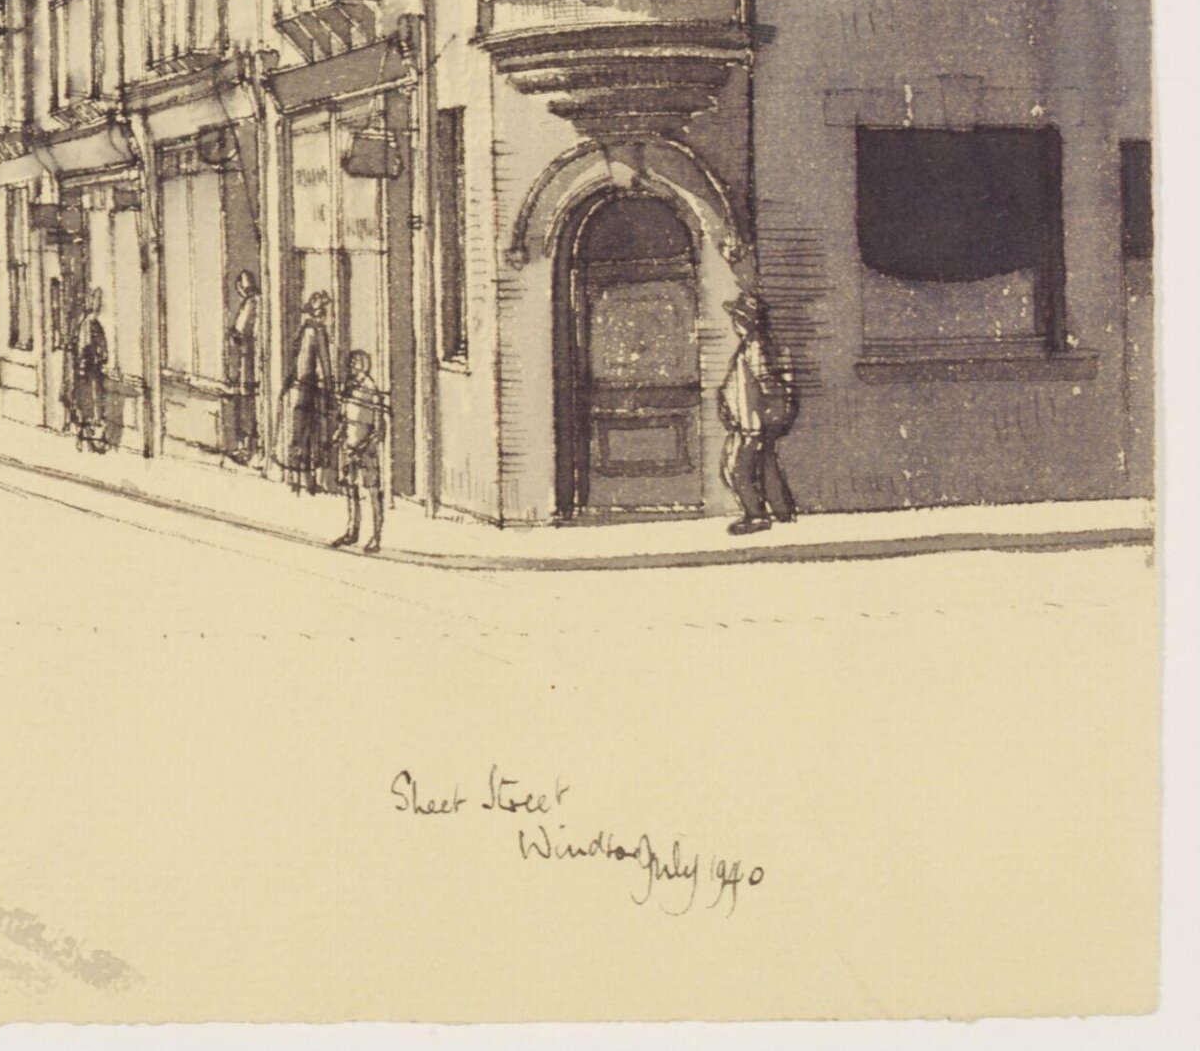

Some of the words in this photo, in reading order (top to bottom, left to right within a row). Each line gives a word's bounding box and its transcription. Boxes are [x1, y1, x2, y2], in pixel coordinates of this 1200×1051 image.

[391, 770, 467, 815] Sheet
[482, 764, 570, 814] Street
[631, 834, 699, 916] July
[707, 854, 764, 918] 1940
